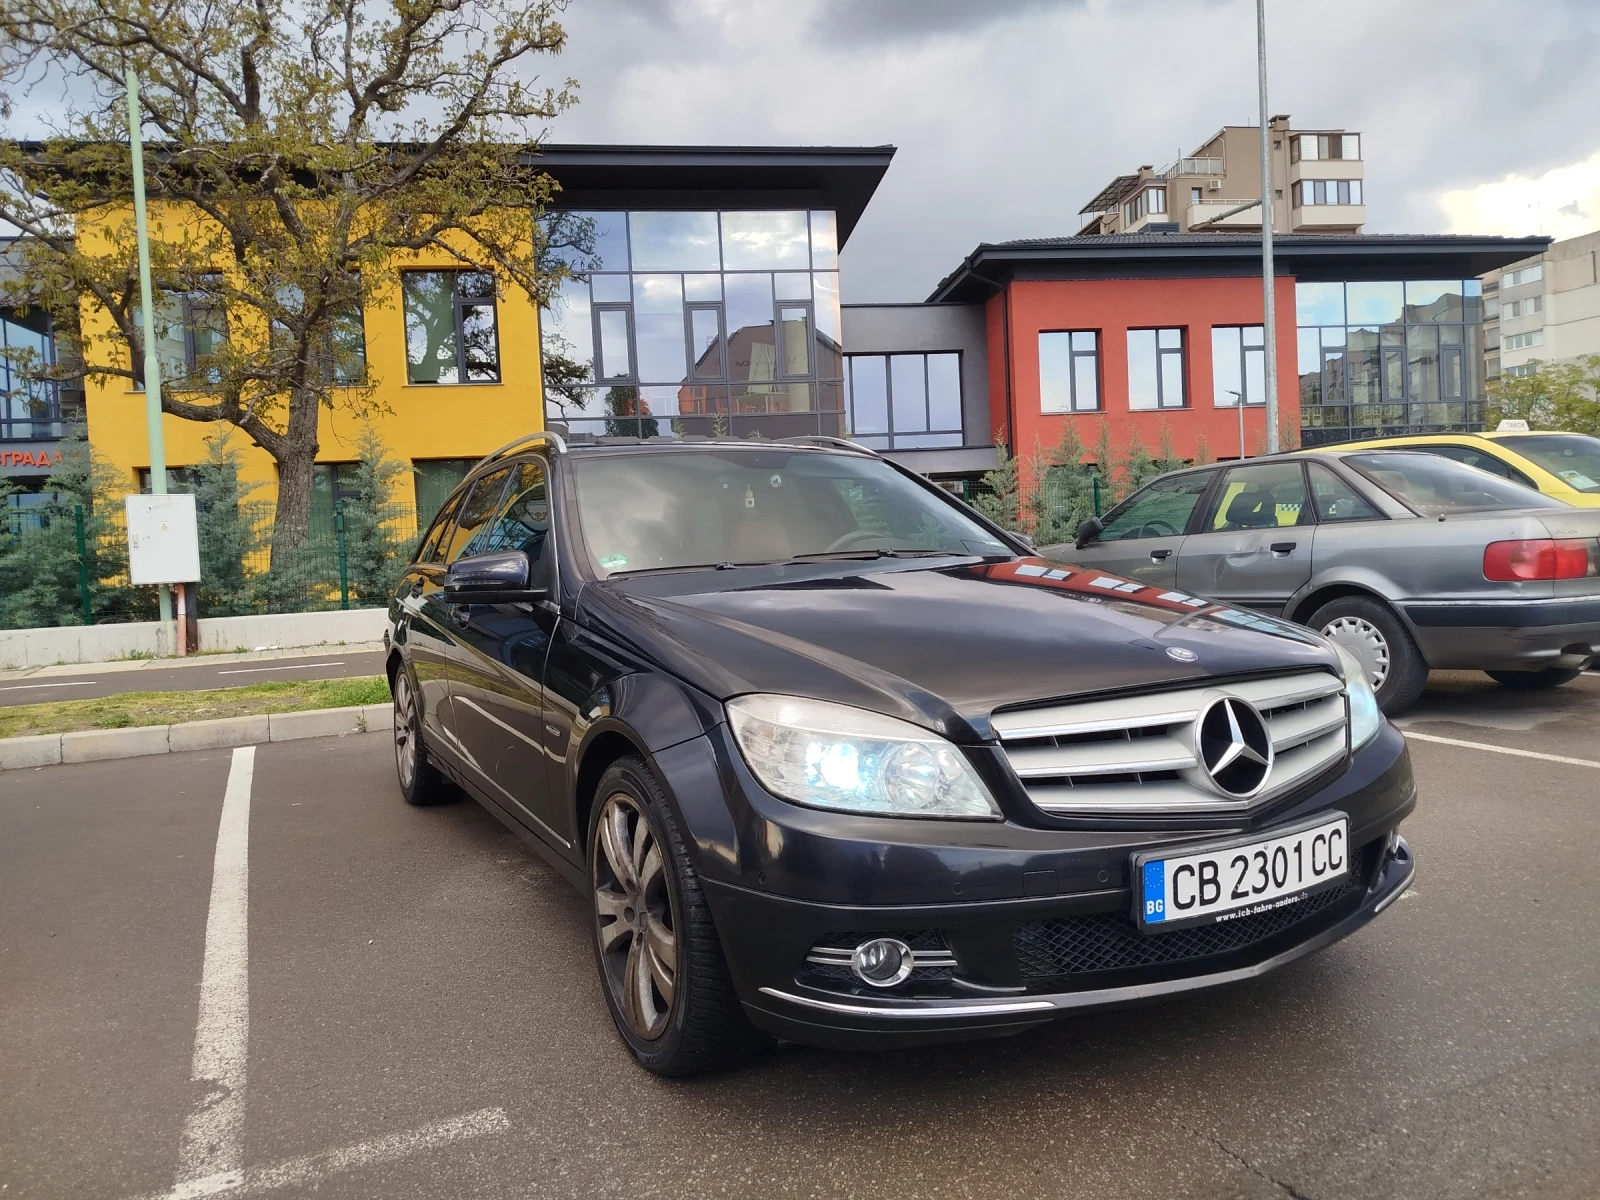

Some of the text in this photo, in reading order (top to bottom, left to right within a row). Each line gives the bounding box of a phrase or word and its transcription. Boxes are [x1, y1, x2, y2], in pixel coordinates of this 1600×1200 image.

[0, 450, 64, 467] ГРАДА
[1172, 828, 1343, 910] CB 2301 CC
[1146, 899, 1164, 915] BG
